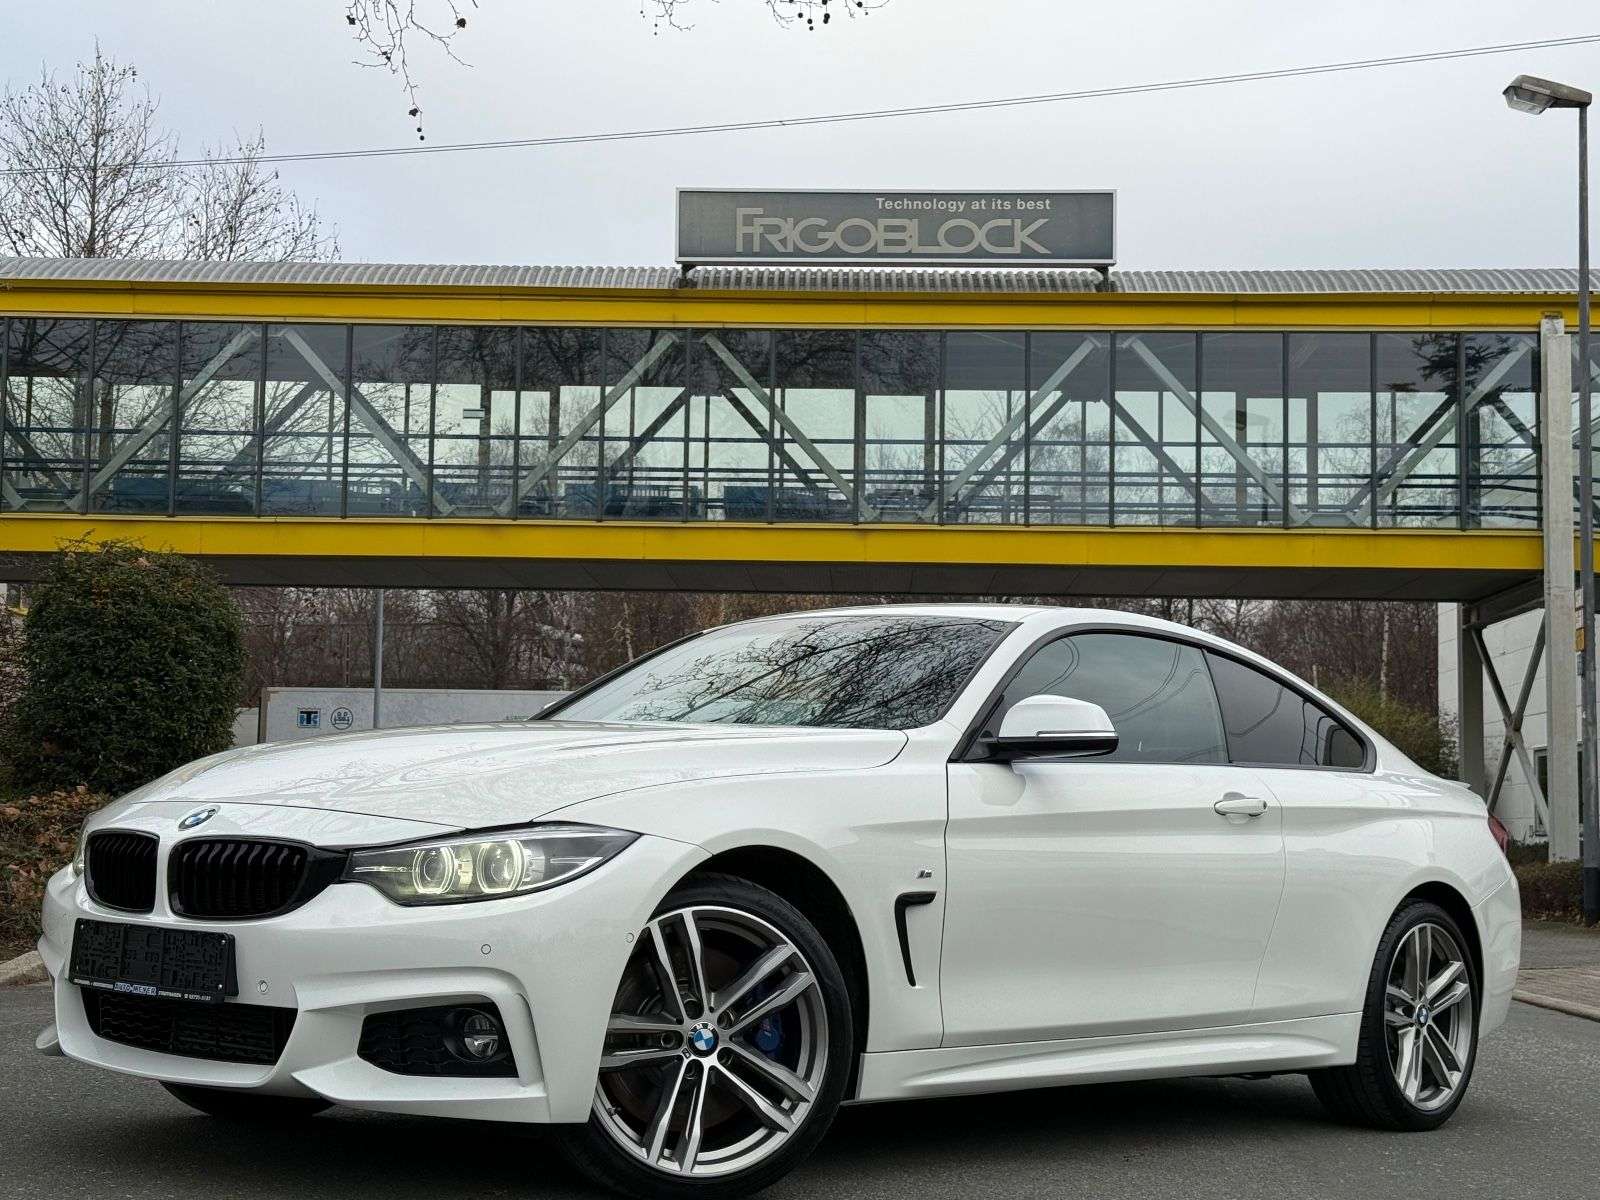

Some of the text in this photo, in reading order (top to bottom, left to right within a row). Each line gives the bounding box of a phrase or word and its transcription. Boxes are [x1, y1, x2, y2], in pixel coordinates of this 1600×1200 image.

[876, 198, 1050, 212] Technology at its best
[735, 207, 1052, 254] FRIGOBLOCK
